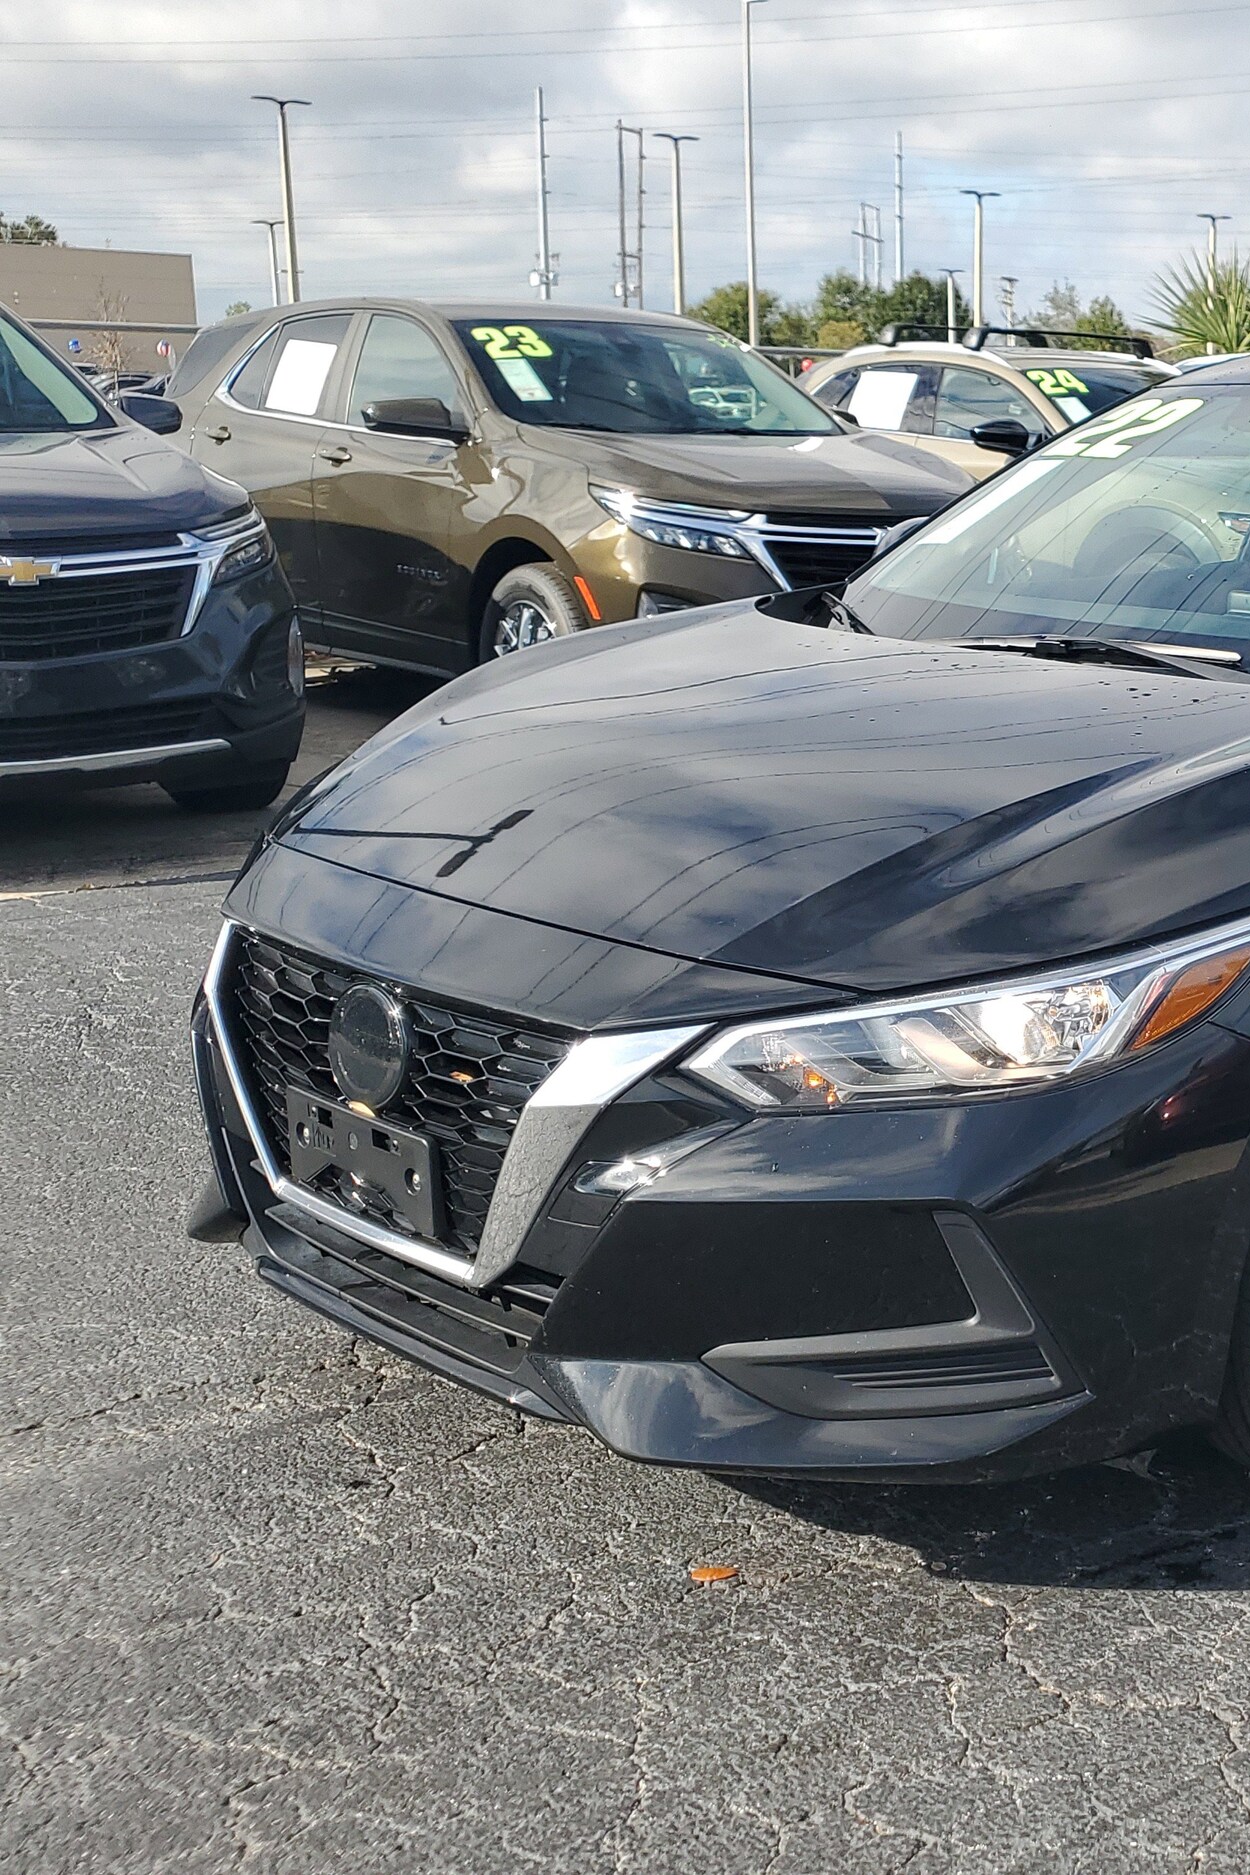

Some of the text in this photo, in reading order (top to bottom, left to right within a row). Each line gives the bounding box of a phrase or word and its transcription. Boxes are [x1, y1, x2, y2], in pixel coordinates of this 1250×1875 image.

[470, 325, 553, 359] 23
[1025, 368, 1091, 395] 24
[1039, 397, 1205, 460] 22
